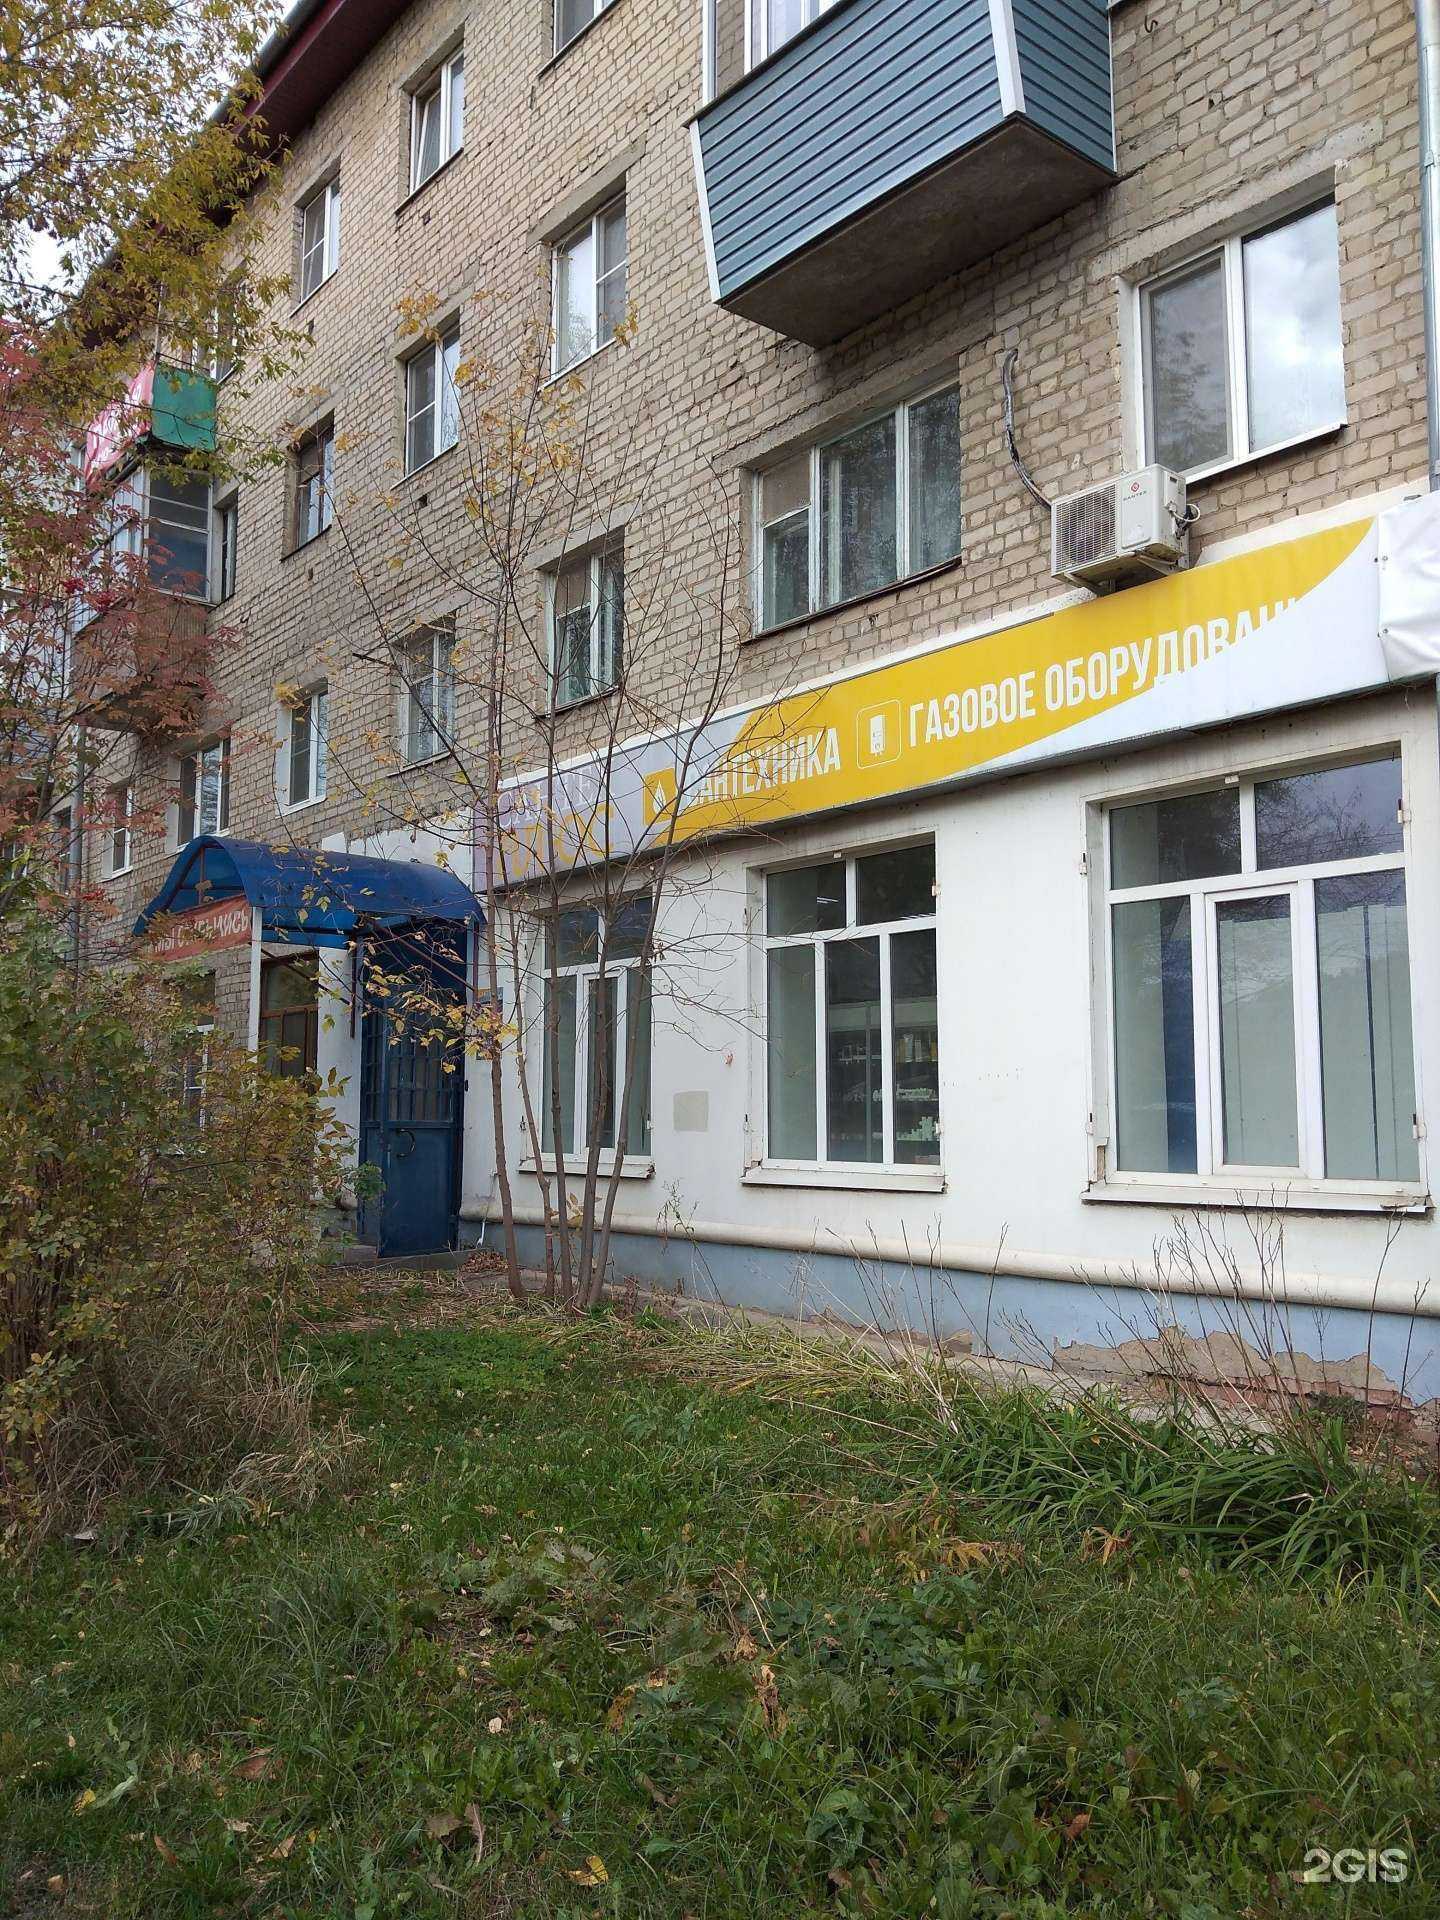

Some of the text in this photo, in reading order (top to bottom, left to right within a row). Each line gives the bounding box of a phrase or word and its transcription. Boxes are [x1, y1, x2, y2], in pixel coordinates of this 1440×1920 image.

[687, 597, 1297, 806] АНТЕХНИКА ГАЗОВОЕ ОБОРУДОВА
[498, 760, 617, 829] САНТЕ
